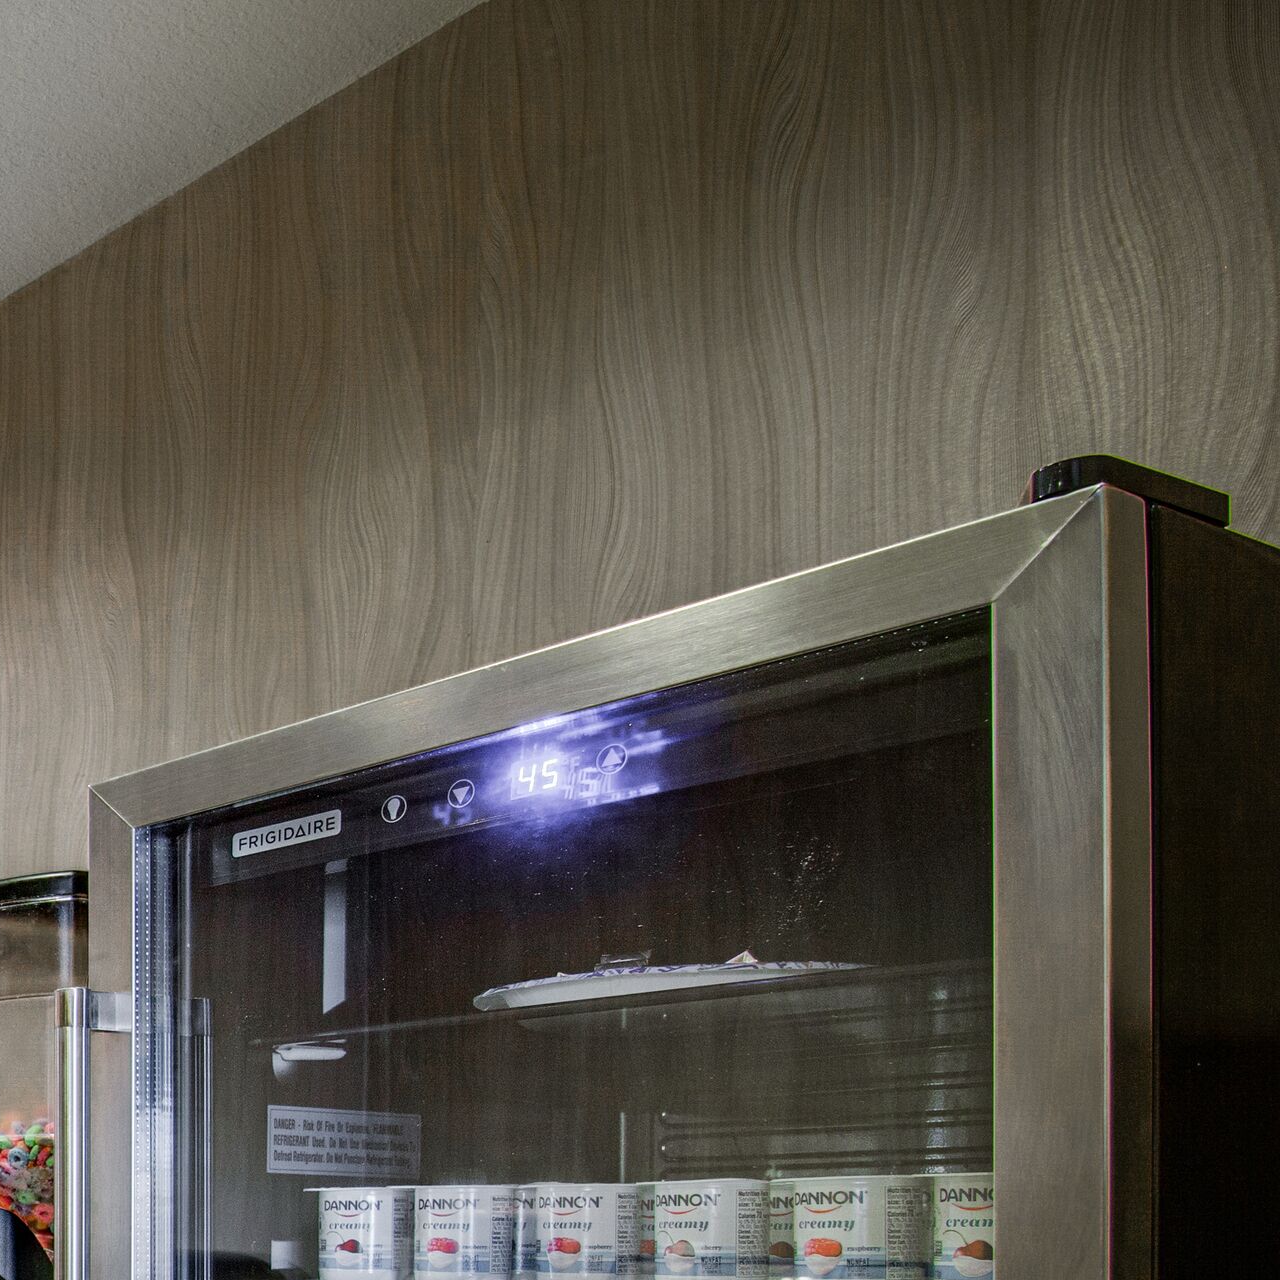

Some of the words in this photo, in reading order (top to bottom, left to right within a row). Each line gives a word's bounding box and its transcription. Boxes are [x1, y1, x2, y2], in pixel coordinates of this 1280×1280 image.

[518, 758, 559, 793] 45
[238, 816, 336, 852] FRIGIDAIRE
[274, 1118, 296, 1130] DANGER
[274, 1134, 310, 1147] REFRIGERANT
[540, 1196, 600, 1209] DANNON
[656, 1193, 718, 1207] DANNON
[795, 1190, 864, 1205] DANNON
[324, 1200, 381, 1212] DANNON
[418, 1199, 477, 1211] DANNON
[422, 1222, 471, 1232] creamy
[543, 1221, 593, 1232] creamy
[658, 1220, 709, 1232] creamy
[799, 1219, 855, 1231] creamy
